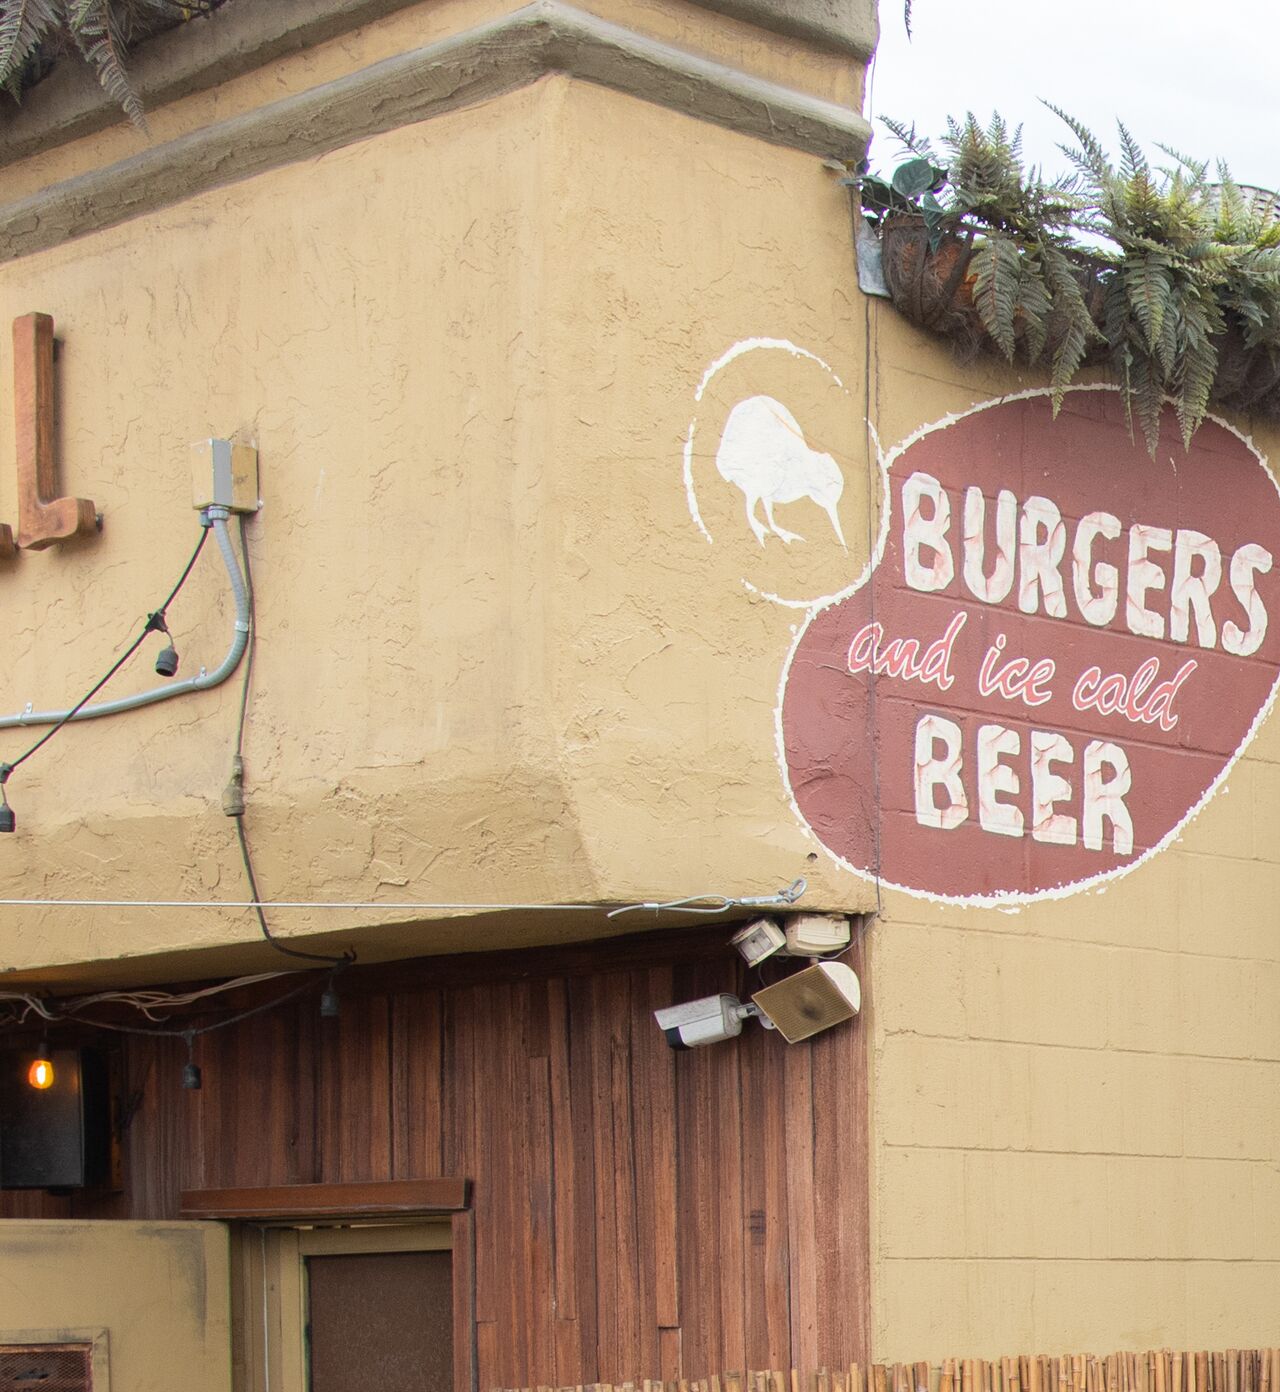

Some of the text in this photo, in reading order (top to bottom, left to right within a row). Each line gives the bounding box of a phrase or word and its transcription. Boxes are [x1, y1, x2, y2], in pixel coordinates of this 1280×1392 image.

[901, 471, 1274, 657] BURGERS
[848, 611, 1198, 732] and ice cold
[914, 714, 1134, 856] BEER
